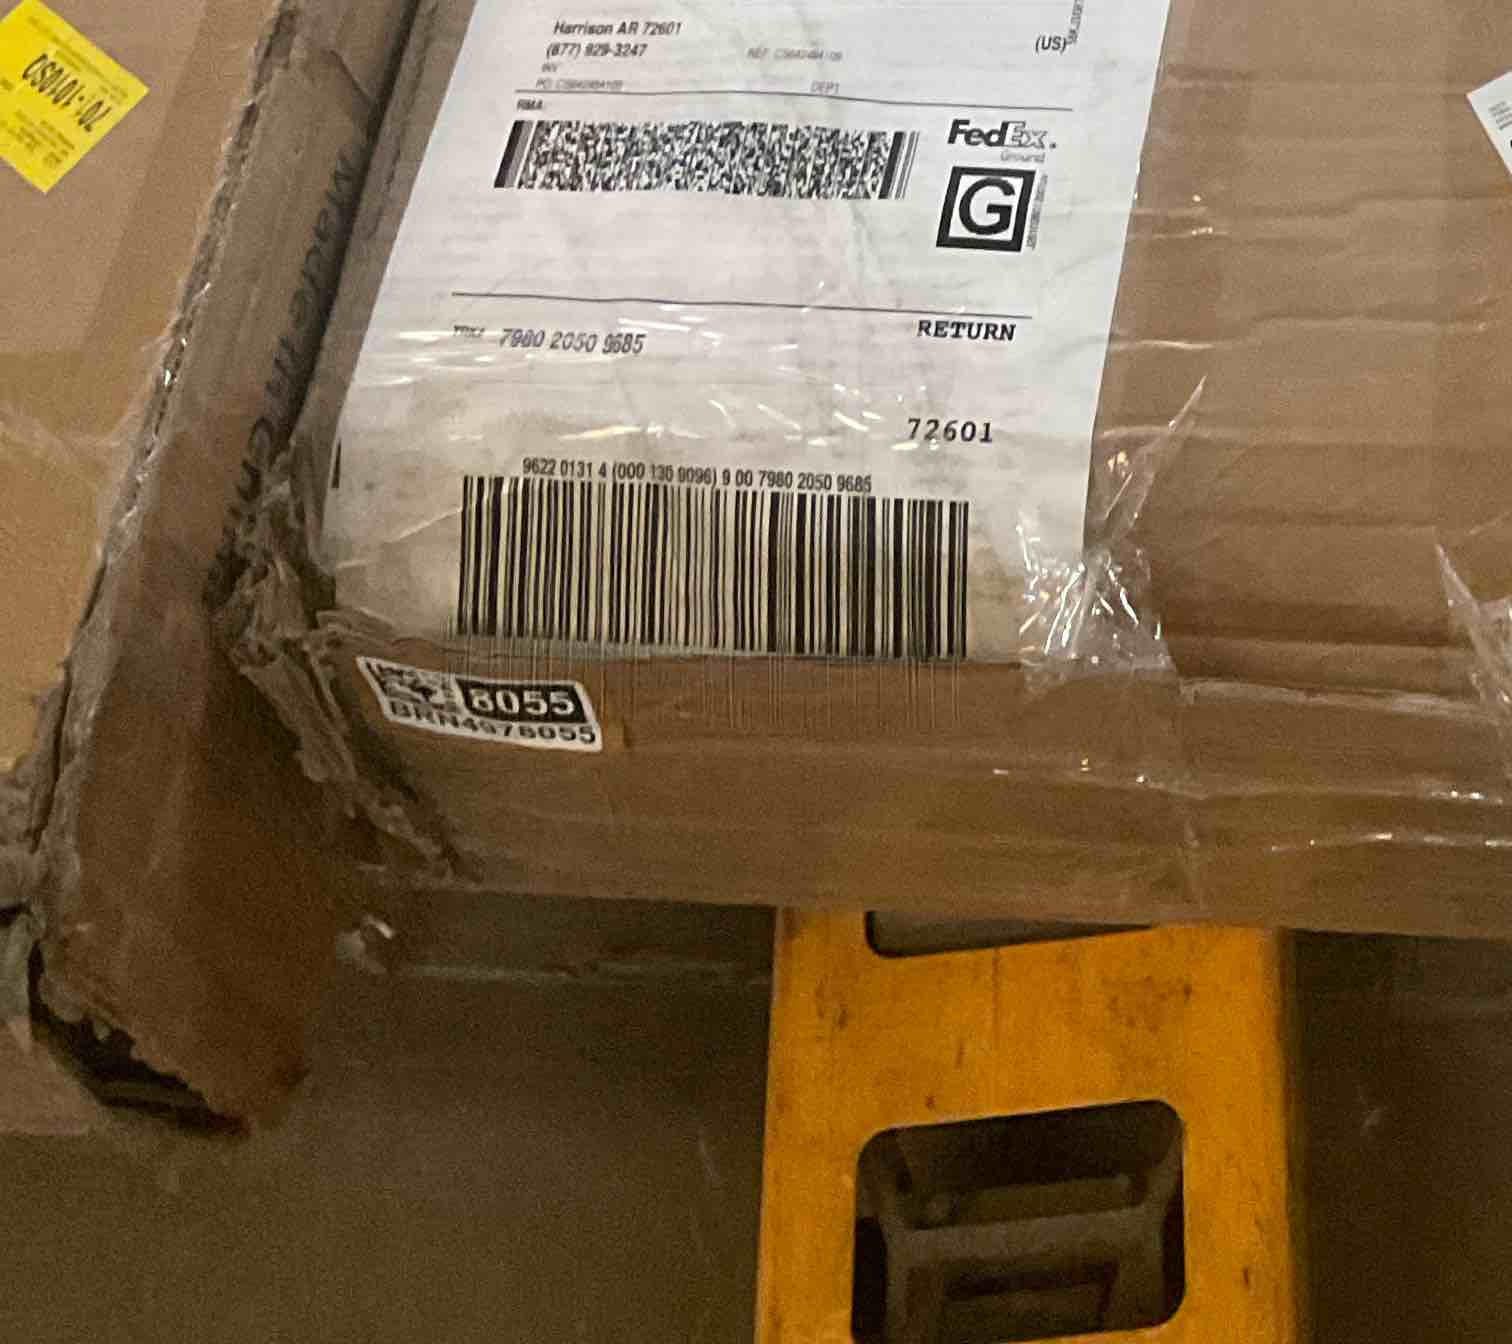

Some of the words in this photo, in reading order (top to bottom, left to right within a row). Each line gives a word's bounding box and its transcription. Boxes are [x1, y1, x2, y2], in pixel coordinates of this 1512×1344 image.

[553, 20, 614, 36] Harrison
[615, 21, 639, 36] AR
[641, 21, 683, 37] 72601
[1034, 34, 1069, 55] (US)
[947, 118, 1049, 150] FedEx
[958, 177, 1017, 236] G
[549, 331, 600, 353] 2050
[916, 318, 1016, 345] RETURN
[906, 416, 995, 445] 72601
[522, 457, 557, 475] 9622
[560, 460, 594, 478] 0131
[597, 461, 608, 478] 4
[735, 466, 754, 486] 00
[758, 468, 794, 488] 7980
[798, 470, 834, 491] 2050
[468, 686, 576, 716] 8055
